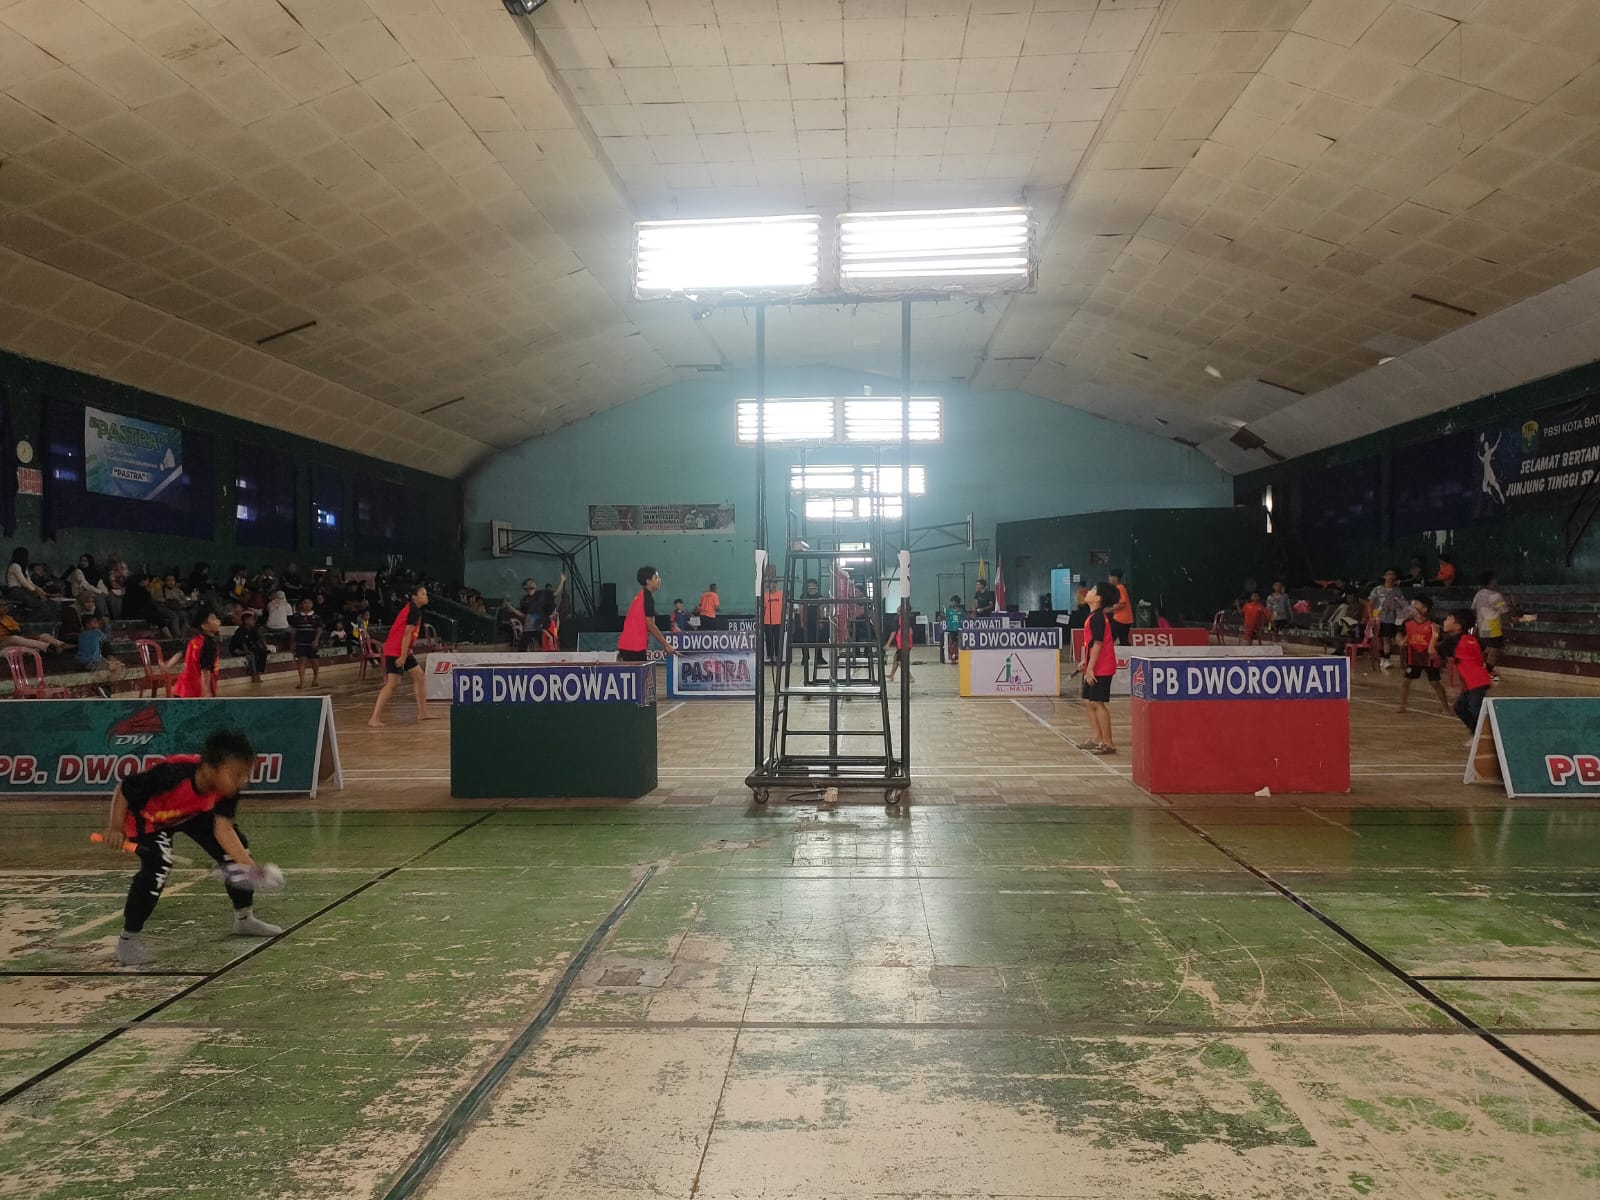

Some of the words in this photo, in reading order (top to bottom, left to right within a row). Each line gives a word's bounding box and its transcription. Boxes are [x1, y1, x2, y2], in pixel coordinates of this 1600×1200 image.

[1563, 422, 1583, 433] KOTA
[1520, 454, 1561, 475] SELAMAT
[1562, 445, 1600, 467] BERTAN
[1506, 478, 1545, 497] JUNJUNG
[1547, 472, 1579, 491] TINGGI
[962, 633, 975, 647] PB
[980, 631, 1056, 647] DWOROWATI
[1132, 634, 1174, 646] PBSI
[681, 659, 751, 682] PASTRA
[1152, 667, 1179, 695] PB
[1187, 664, 1341, 695] DWOROWATI
[459, 674, 484, 703] PB
[492, 672, 637, 703] DWOROWATI
[115, 734, 154, 745] DW
